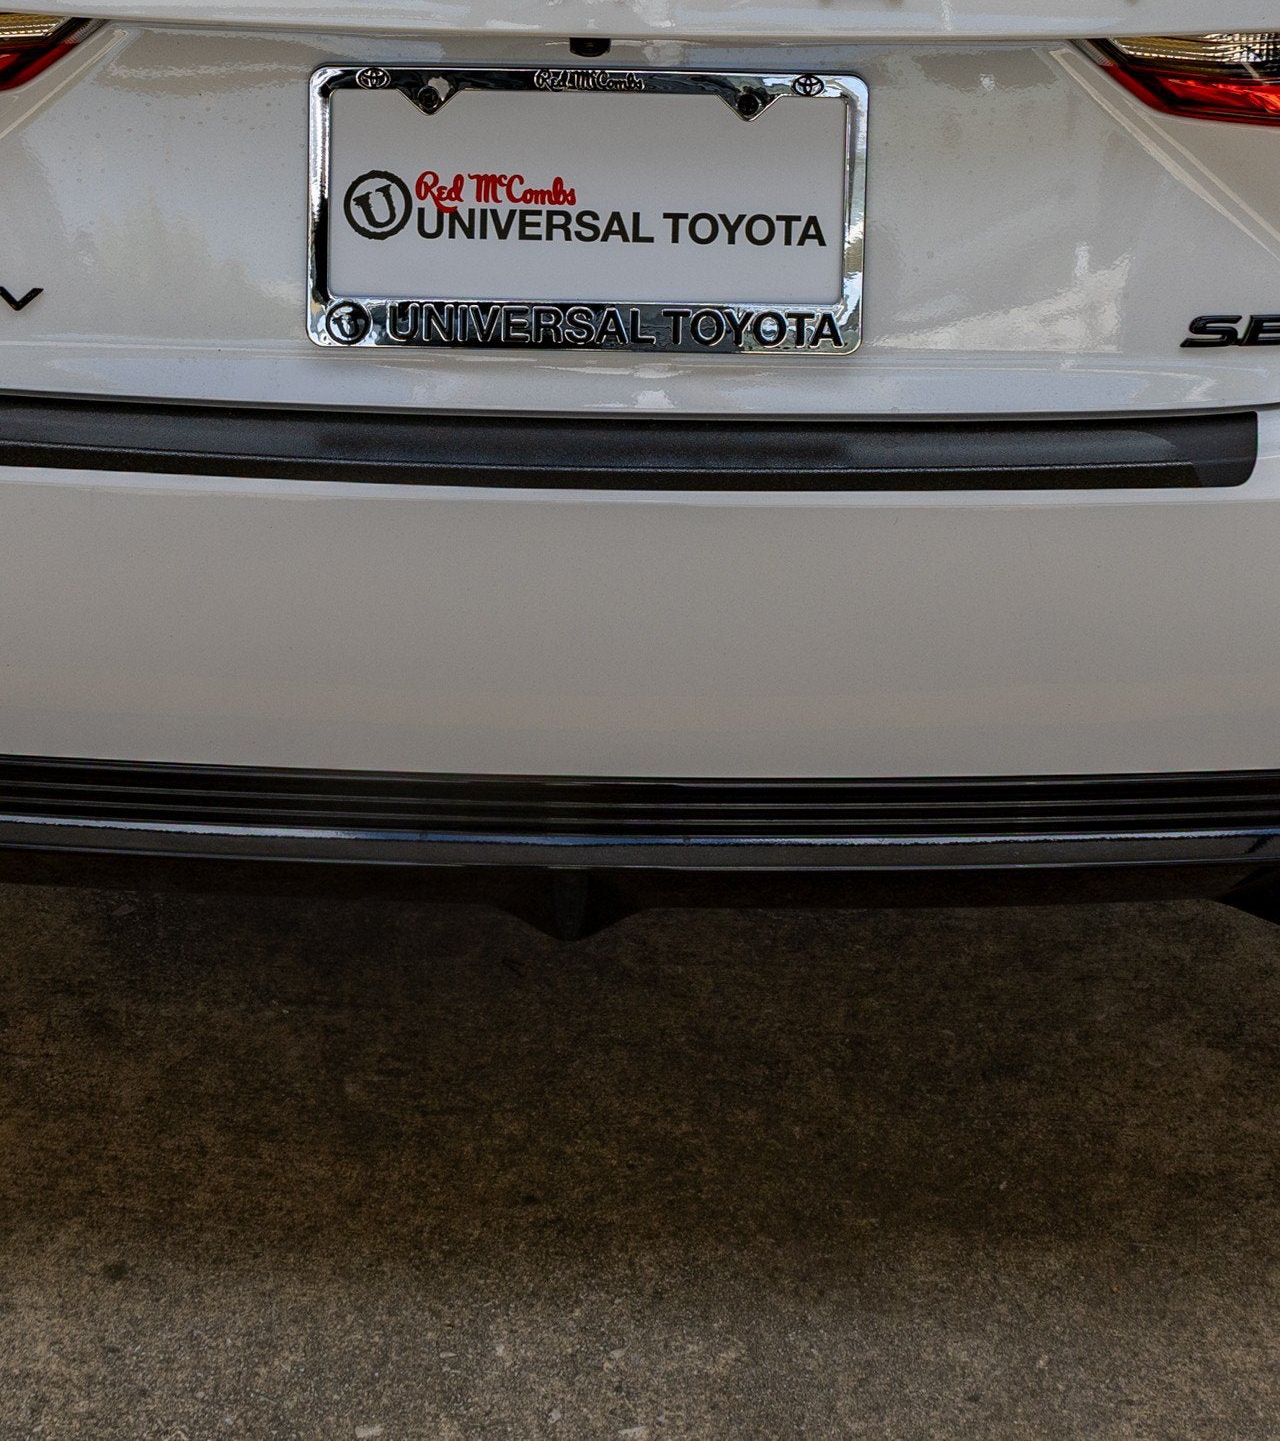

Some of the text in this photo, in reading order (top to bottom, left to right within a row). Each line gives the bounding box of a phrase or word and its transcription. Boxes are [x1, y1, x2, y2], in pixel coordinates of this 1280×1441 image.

[415, 170, 577, 213] Red McCombs
[417, 206, 827, 247] UNIVERSAL TOYOTA
[387, 301, 845, 350] UNIVERSAL TOYOTA
